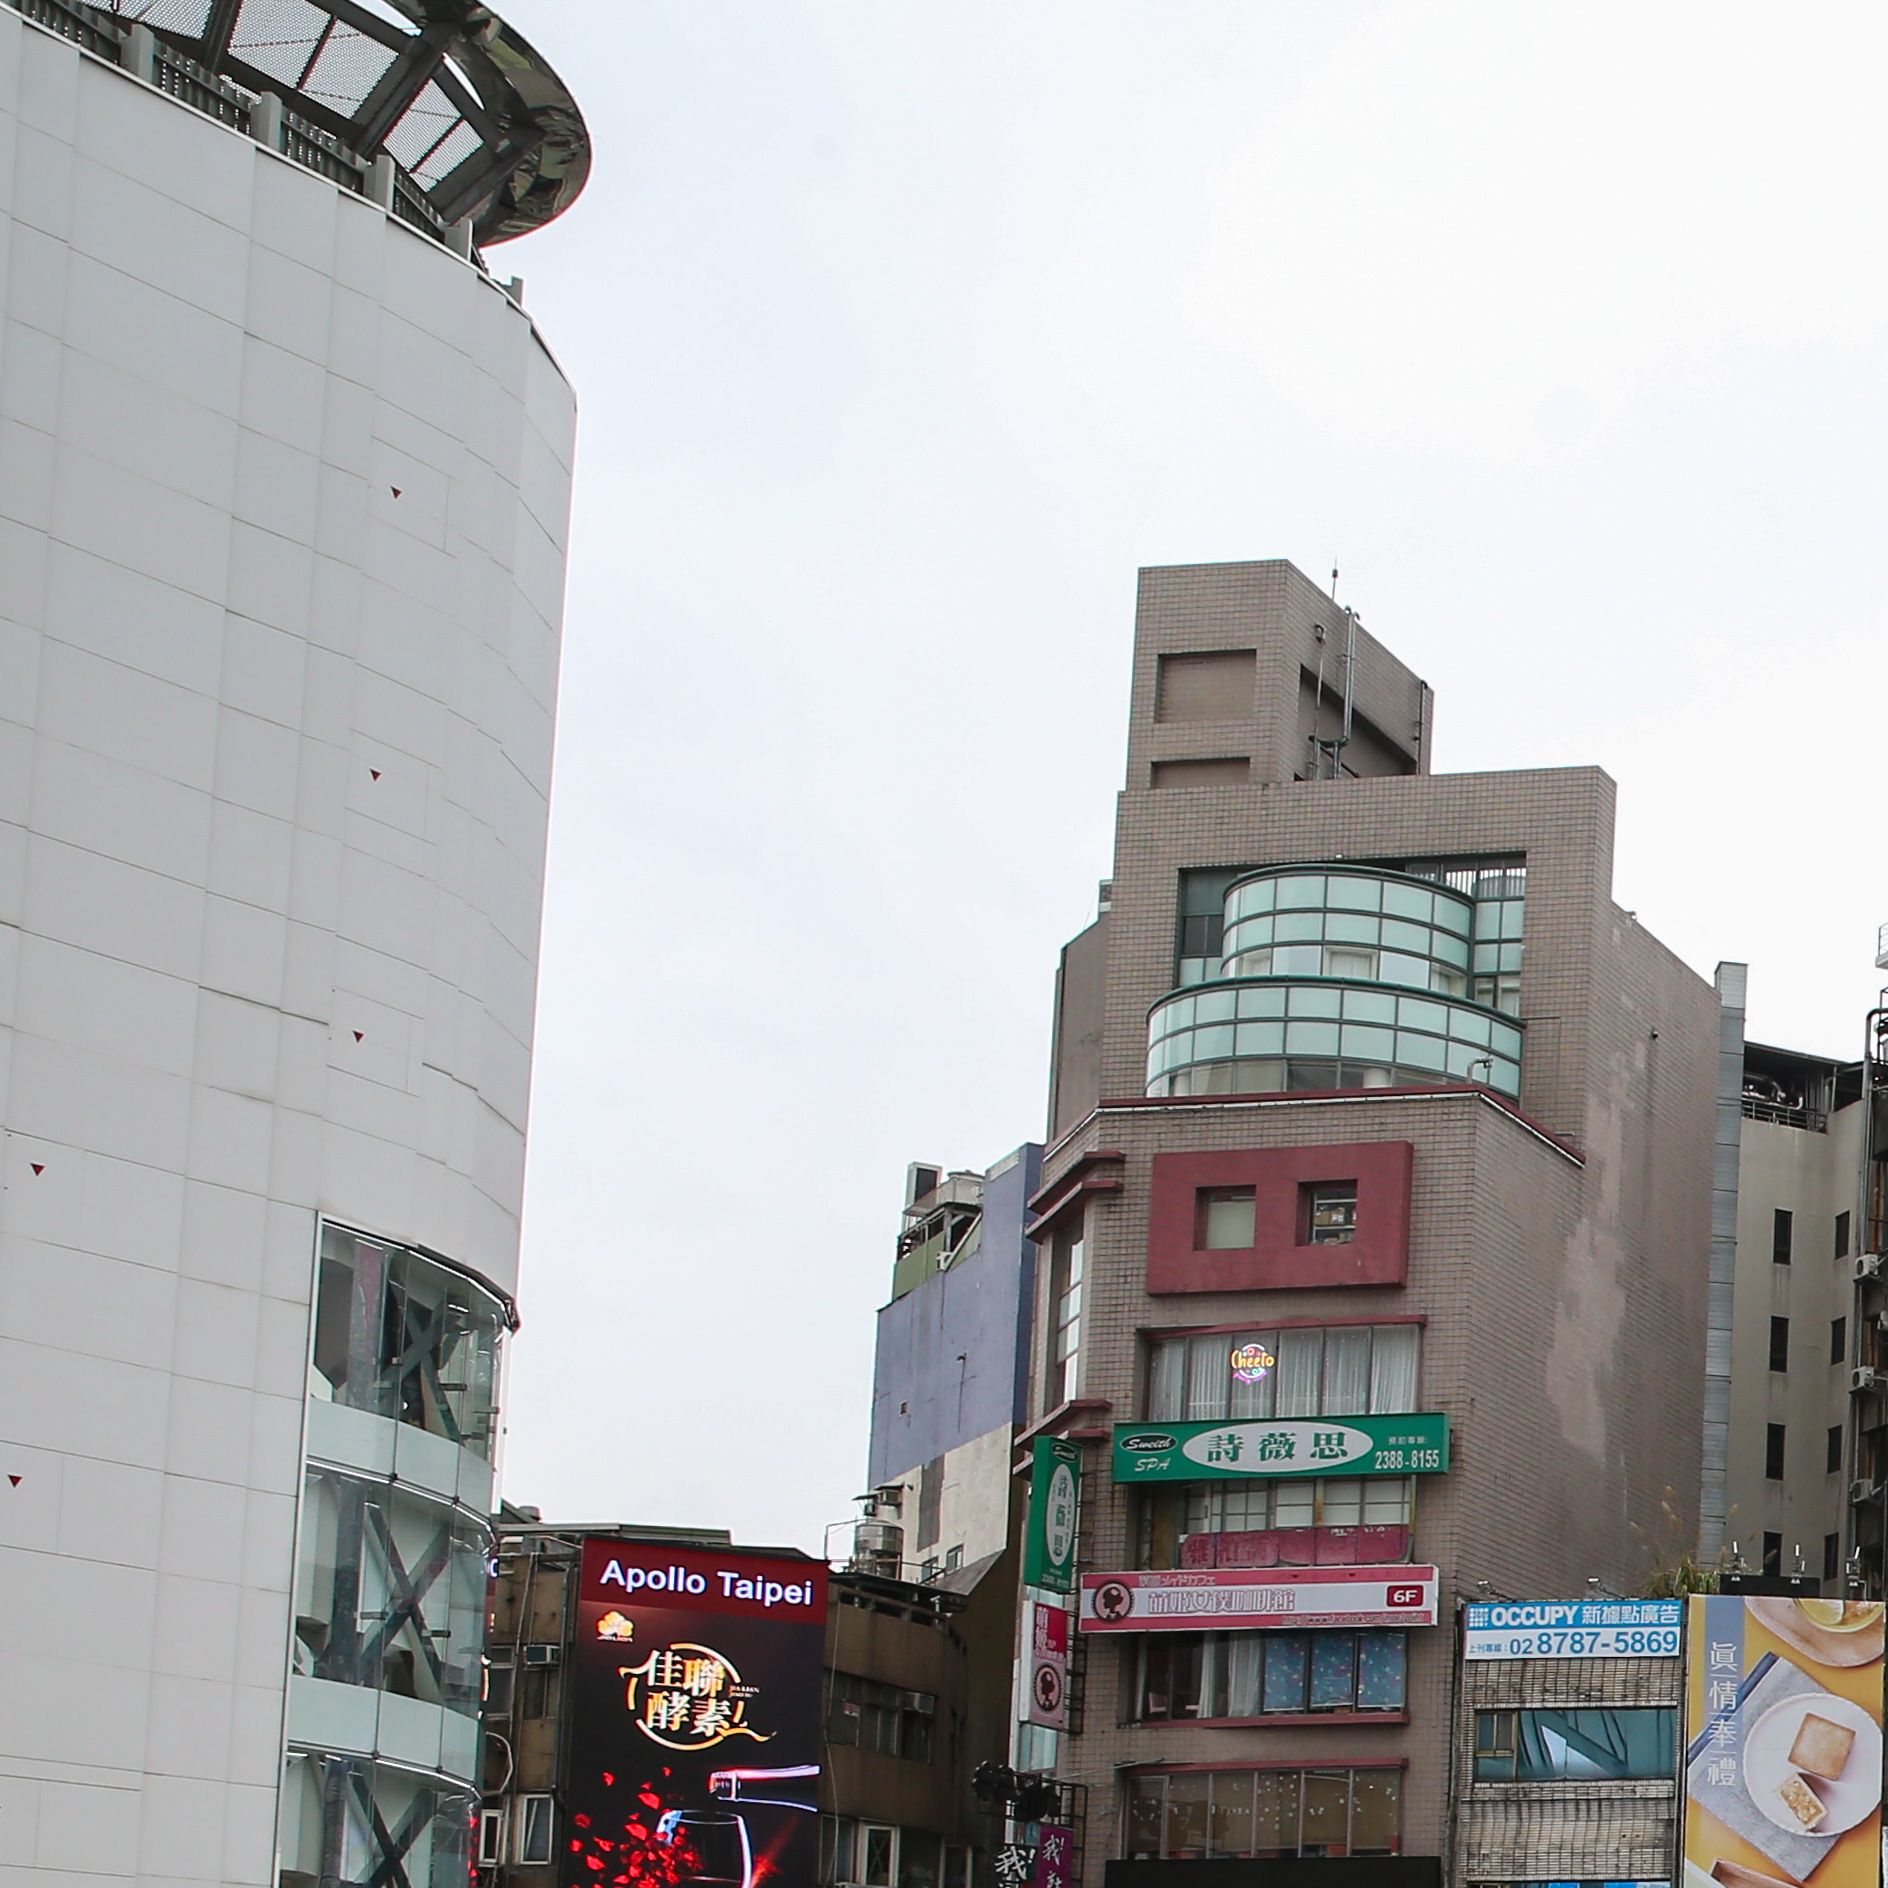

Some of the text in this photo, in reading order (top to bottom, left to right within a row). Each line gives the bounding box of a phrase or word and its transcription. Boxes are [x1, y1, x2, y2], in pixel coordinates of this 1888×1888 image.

[1207, 1431, 1348, 1462] 詩薇思
[1134, 1458, 1171, 1472] SPA
[1375, 1450, 1439, 1470] 2388-8155
[600, 1559, 812, 1608] Apollo Taipei
[1393, 1589, 1418, 1603] 6F
[1491, 1605, 1681, 1628] OCCUPY 新據點廣告
[1509, 1637, 1533, 1655] 02
[1537, 1630, 1679, 1655] 8787-5869
[627, 1649, 728, 1698] 佳聯
[646, 1691, 732, 1737] 酵素
